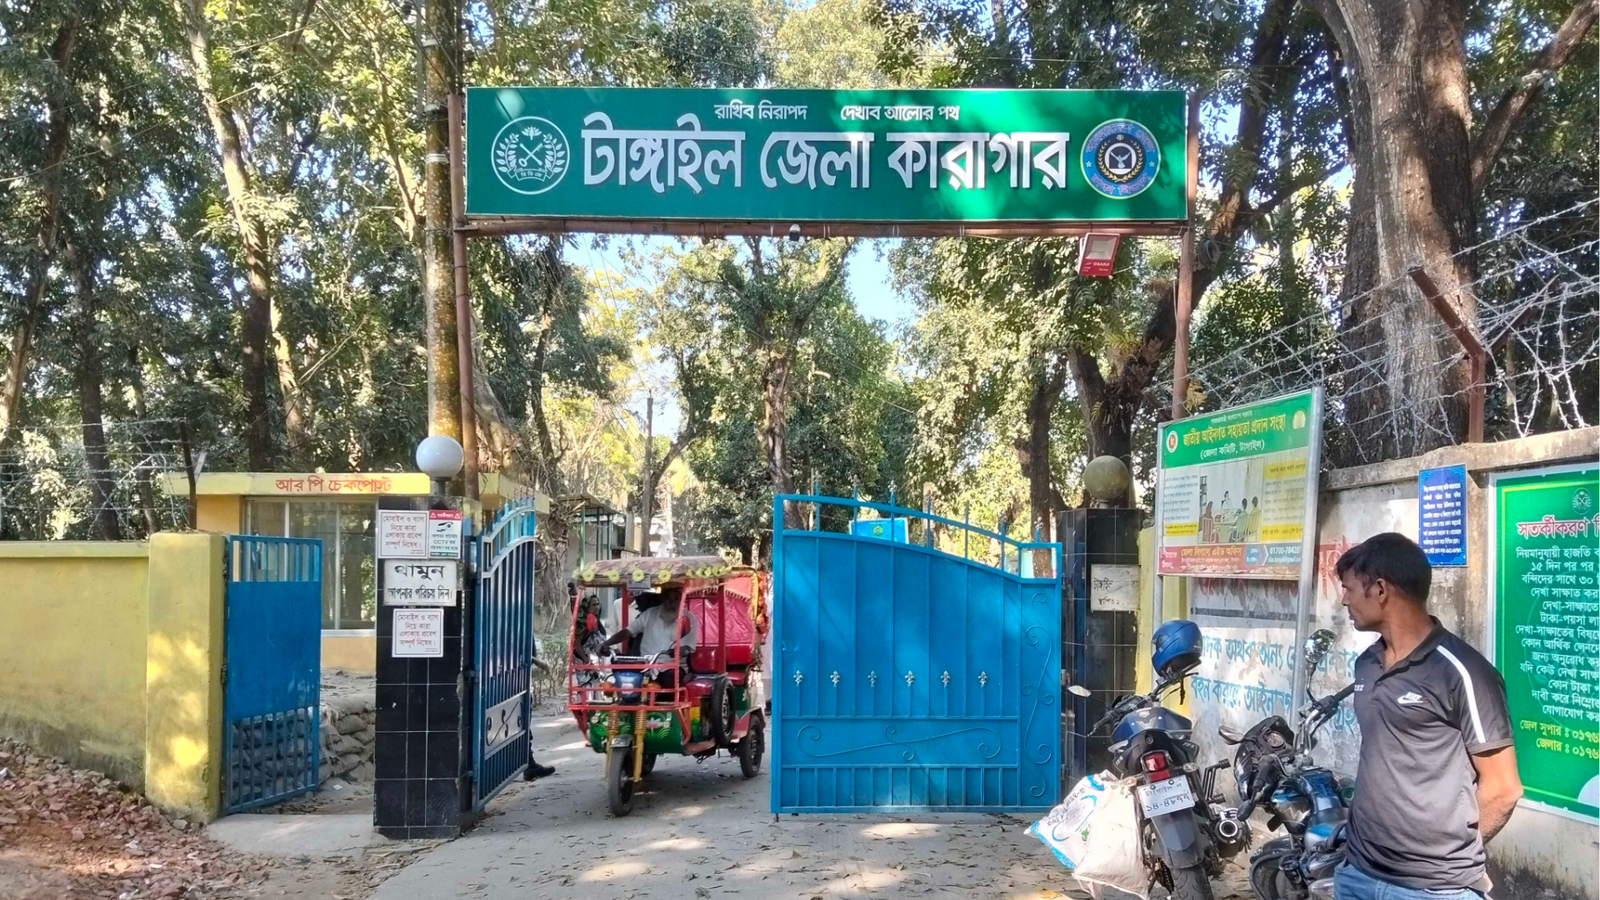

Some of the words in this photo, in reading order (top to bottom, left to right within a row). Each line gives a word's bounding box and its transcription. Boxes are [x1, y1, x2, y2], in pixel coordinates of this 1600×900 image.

[714, 99, 754, 120] রাখিব
[758, 100, 808, 120] নিরাপদ
[840, 104, 880, 121] দেখাব
[884, 104, 933, 121] আলোর
[937, 104, 960, 121] পথ
[581, 111, 746, 194] টাঙ্গাইল
[760, 131, 875, 191] জেলা
[885, 131, 1070, 190] কারাগার
[276, 478, 304, 492] আর
[307, 475, 324, 492] পি
[328, 476, 393, 492] চেকপোস্ট
[1516, 545, 1561, 560] নিয়মানুযায়ী
[1563, 545, 1592, 559] হাজতি
[394, 564, 446, 581] থামুন
[1531, 562, 1543, 572] ১৫
[1545, 559, 1561, 571] দিন
[1563, 561, 1577, 572] পর
[1580, 561, 1594, 572] পর
[1521, 571, 1553, 584] বন্দিদের
[1555, 574, 1576, 585] সাথে
[1579, 576, 1593, 585] ৩০
[1530, 587, 1549, 597] দেখা
[1551, 588, 1581, 598] সাক্ষাত
[1539, 611, 1587, 626] টাকা-পয়সা
[1515, 624, 1575, 638] দেখা-সাক্ষাতের
[1203, 635, 1222, 659] াদক
[1521, 638, 1541, 649] কোন
[1543, 637, 1571, 651] আর্থিক
[1532, 651, 1549, 662] জন্য
[1551, 653, 1585, 668] অনুরোধ
[1519, 660, 1534, 674] যদি
[1536, 663, 1555, 676] কেউ
[1558, 667, 1577, 679] দেখা
[1191, 675, 1211, 703] বহন
[1548, 679, 1569, 691] কোন
[1570, 679, 1592, 694] টাকা
[1531, 687, 1549, 701] দাবী
[1551, 692, 1569, 704] করে
[1542, 704, 1584, 720] যোগাযোগ
[1520, 719, 1537, 732] জেল
[1539, 722, 1562, 737] সুপার
[1536, 737, 1562, 752] জেলার
